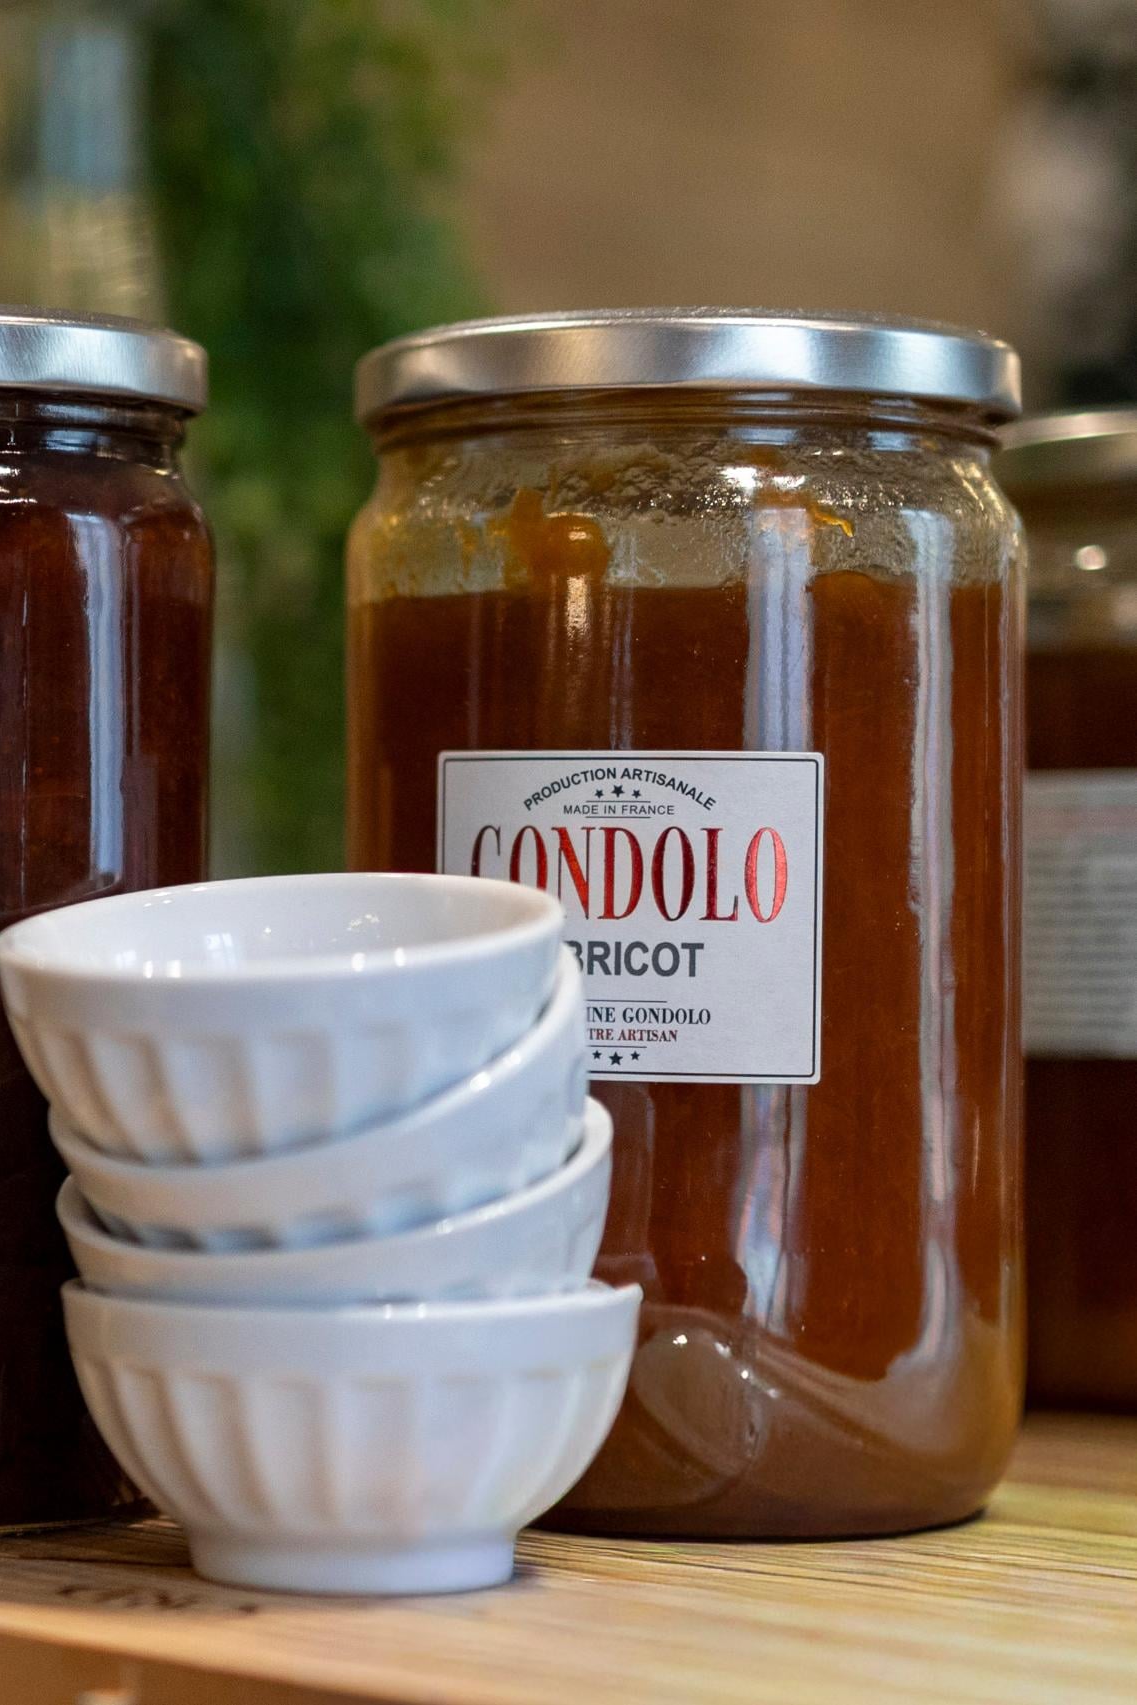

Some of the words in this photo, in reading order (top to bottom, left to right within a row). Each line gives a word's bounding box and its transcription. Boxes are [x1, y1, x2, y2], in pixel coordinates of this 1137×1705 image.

[523, 767, 617, 811] PRODUCTION
[620, 767, 717, 811] ARTISANALE
[563, 804, 601, 815] MADE
[604, 804, 618, 815] IN
[621, 804, 675, 815] FRANCE
[564, 940, 705, 977] RICOT
[622, 1007, 711, 1025] GONDOLO
[618, 1029, 678, 1042] ARTISAN
